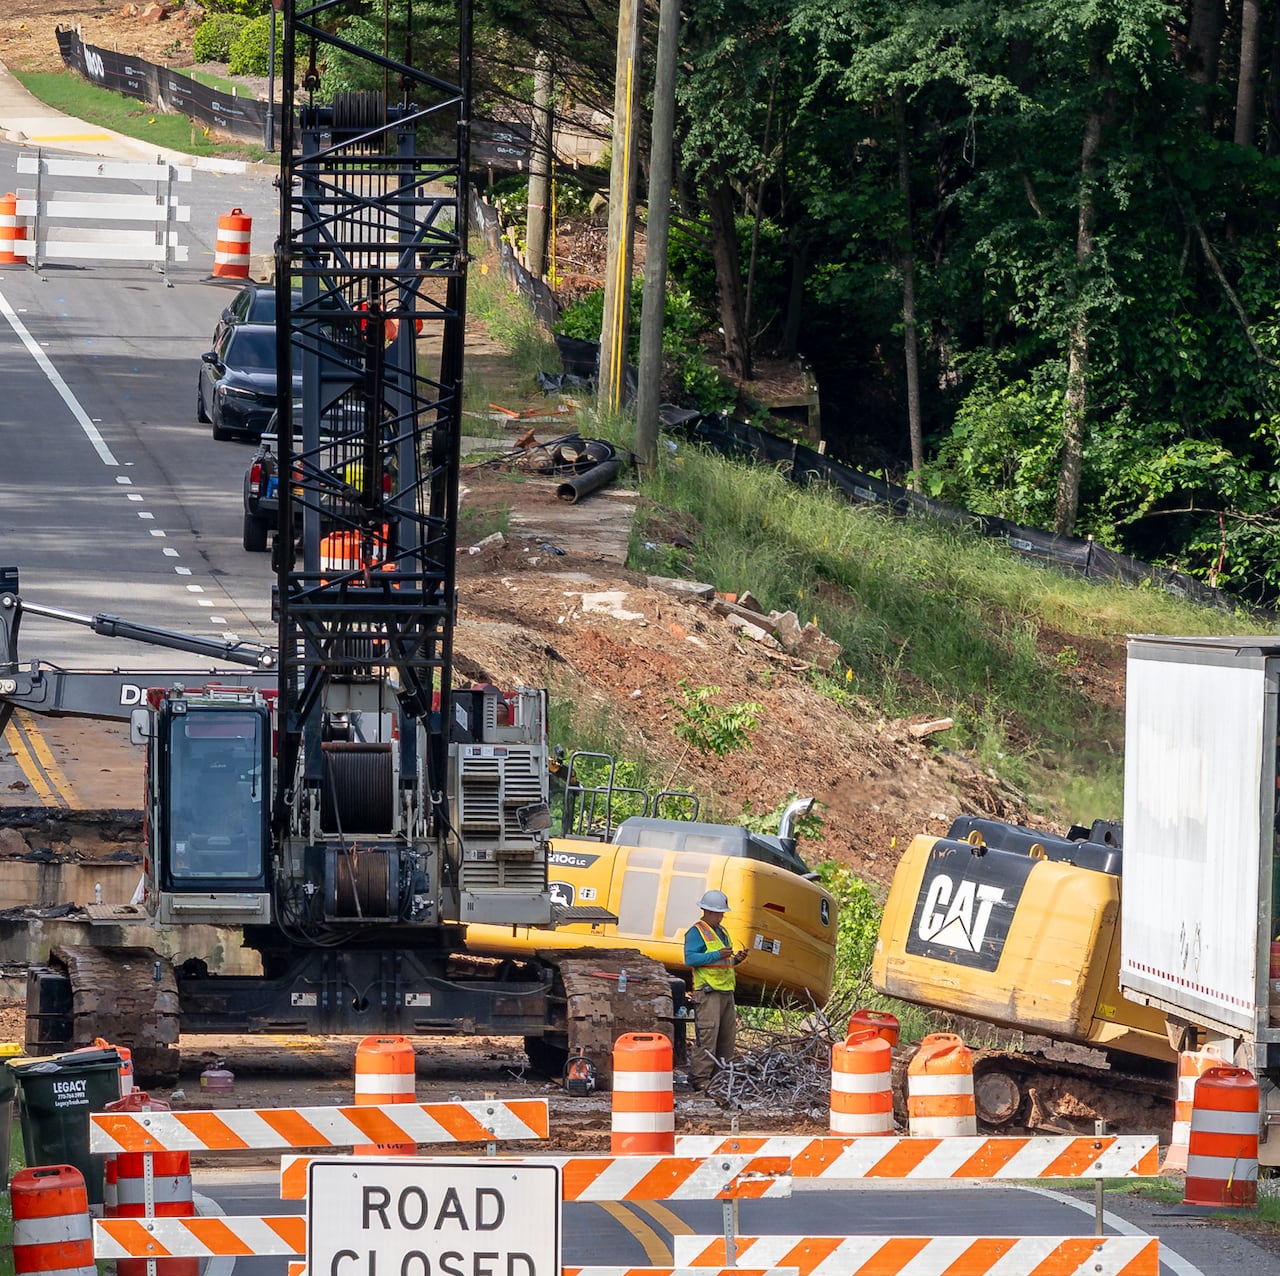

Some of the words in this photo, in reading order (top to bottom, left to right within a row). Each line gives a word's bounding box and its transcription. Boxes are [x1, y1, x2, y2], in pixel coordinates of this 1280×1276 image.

[918, 873, 1006, 953] CAT
[53, 1080, 87, 1094] LEGACY
[361, 1185, 505, 1231] ROAD
